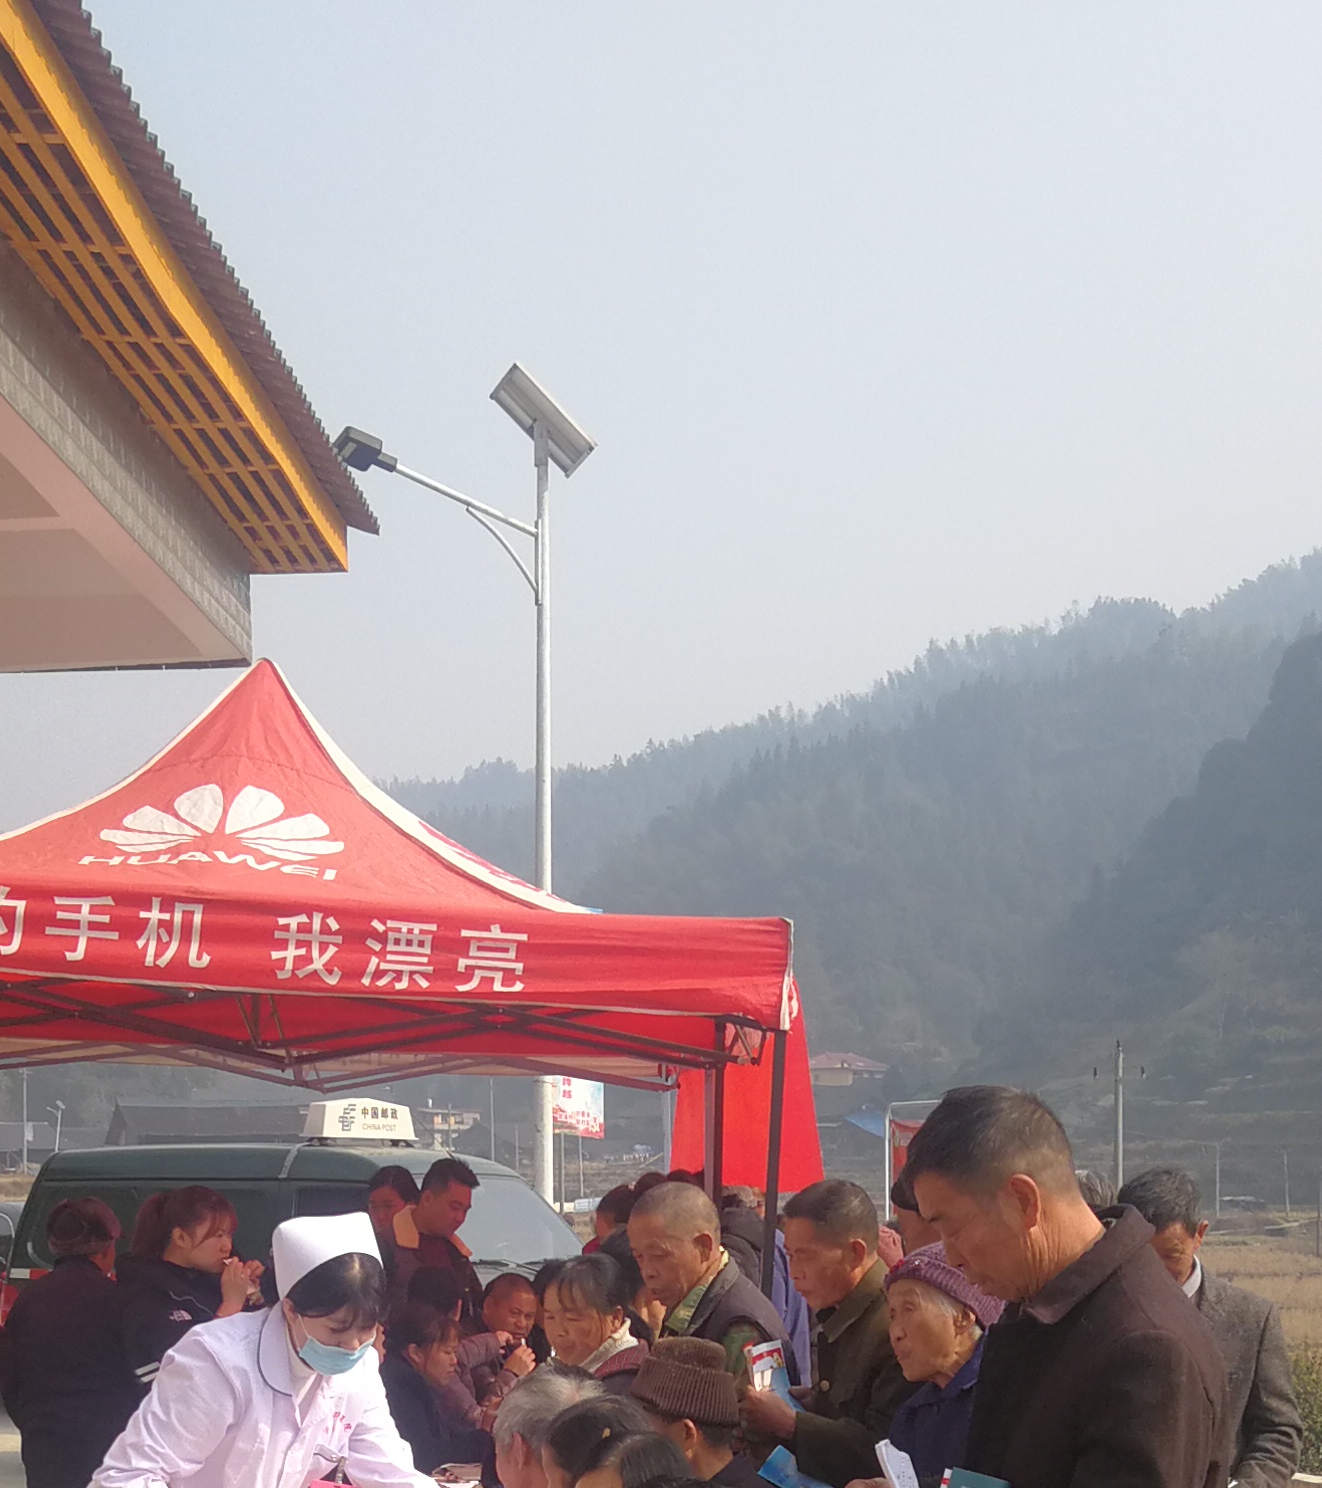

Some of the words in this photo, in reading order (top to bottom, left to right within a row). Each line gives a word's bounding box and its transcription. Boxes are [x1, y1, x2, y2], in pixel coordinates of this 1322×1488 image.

[78, 849, 338, 880] HUAWEI
[270, 912, 529, 993] 我漂亮
[361, 1106, 399, 1121] 中国邮政
